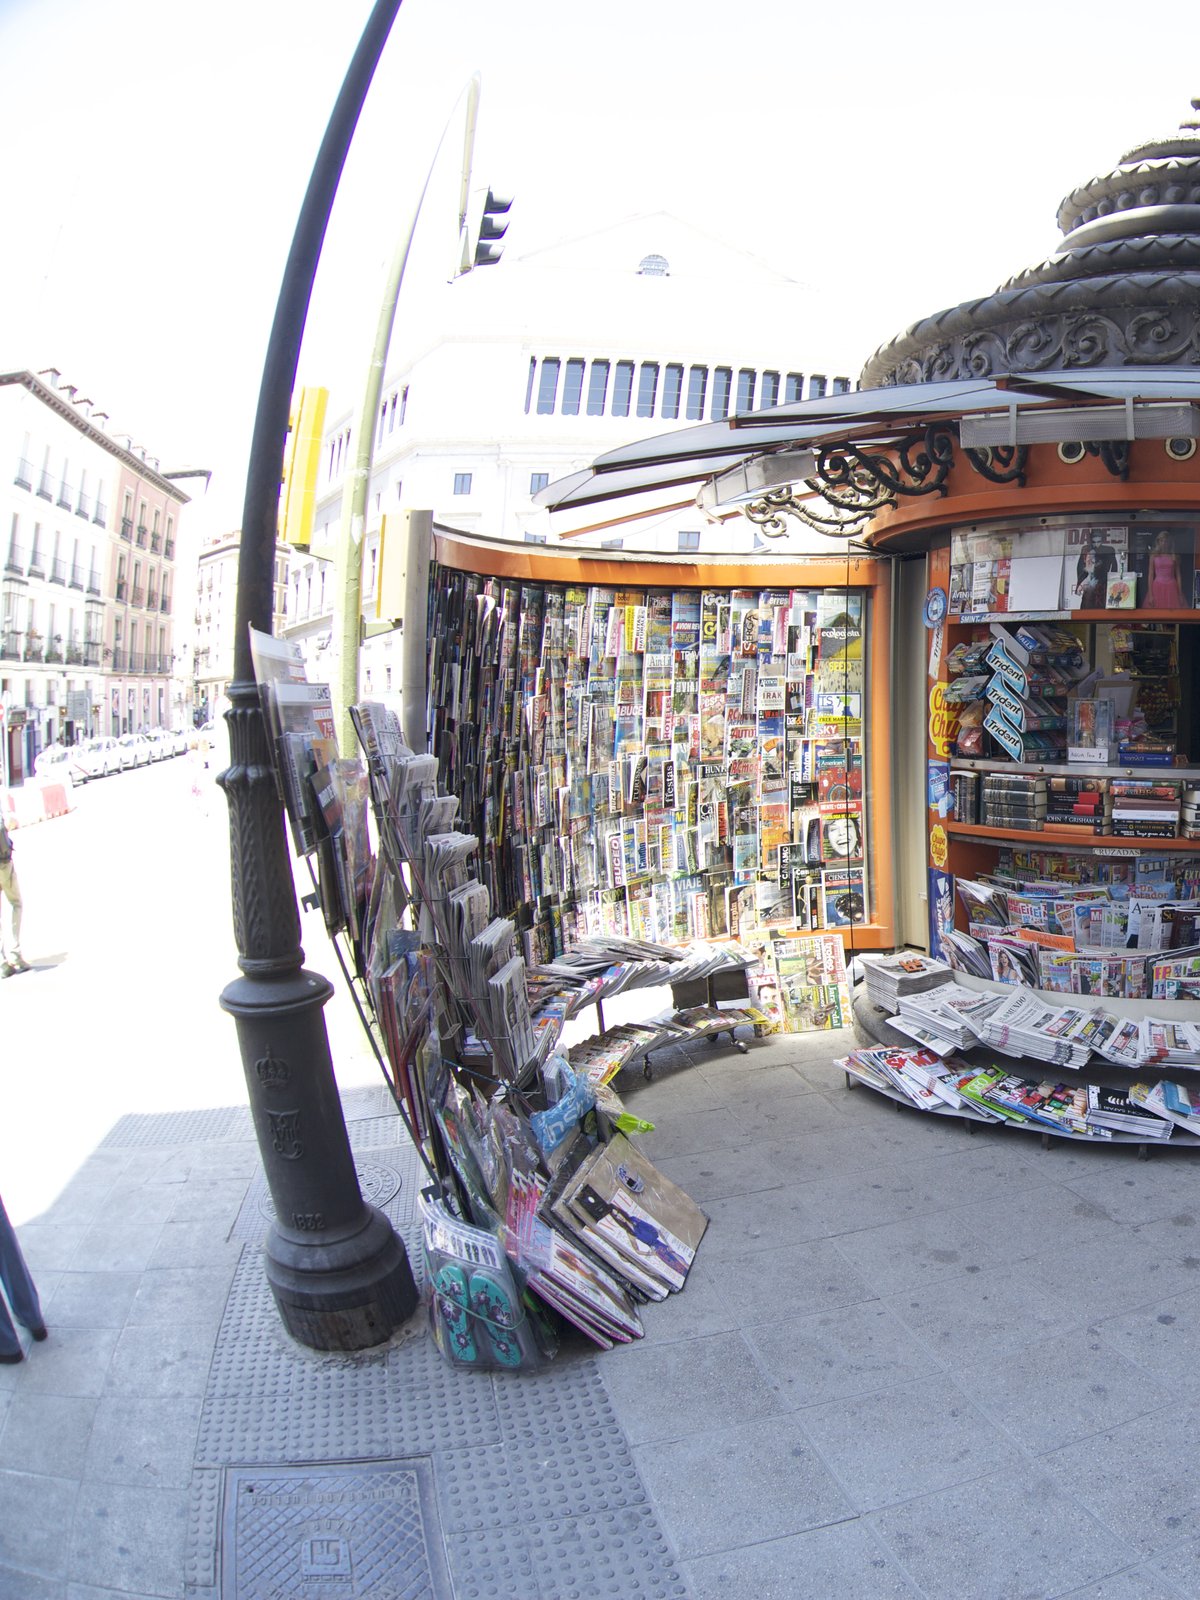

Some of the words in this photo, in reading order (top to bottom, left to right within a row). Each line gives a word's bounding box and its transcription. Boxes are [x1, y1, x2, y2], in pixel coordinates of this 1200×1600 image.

[989, 653, 1024, 683] Trident
[762, 691, 782, 700] IRAK
[987, 686, 1022, 715] Trident
[987, 718, 1020, 747] Trident
[664, 765, 673, 804] fiestas
[1046, 815, 1063, 823] JOHN
[1068, 816, 1096, 825] GRISHAM
[610, 839, 622, 885] BUCEO
[781, 846, 790, 880] CAÑAMO
[1094, 847, 1140, 857] CRUZADAS
[1007, 995, 1027, 1016] MUNDO
[967, 1077, 989, 1094] GEO
